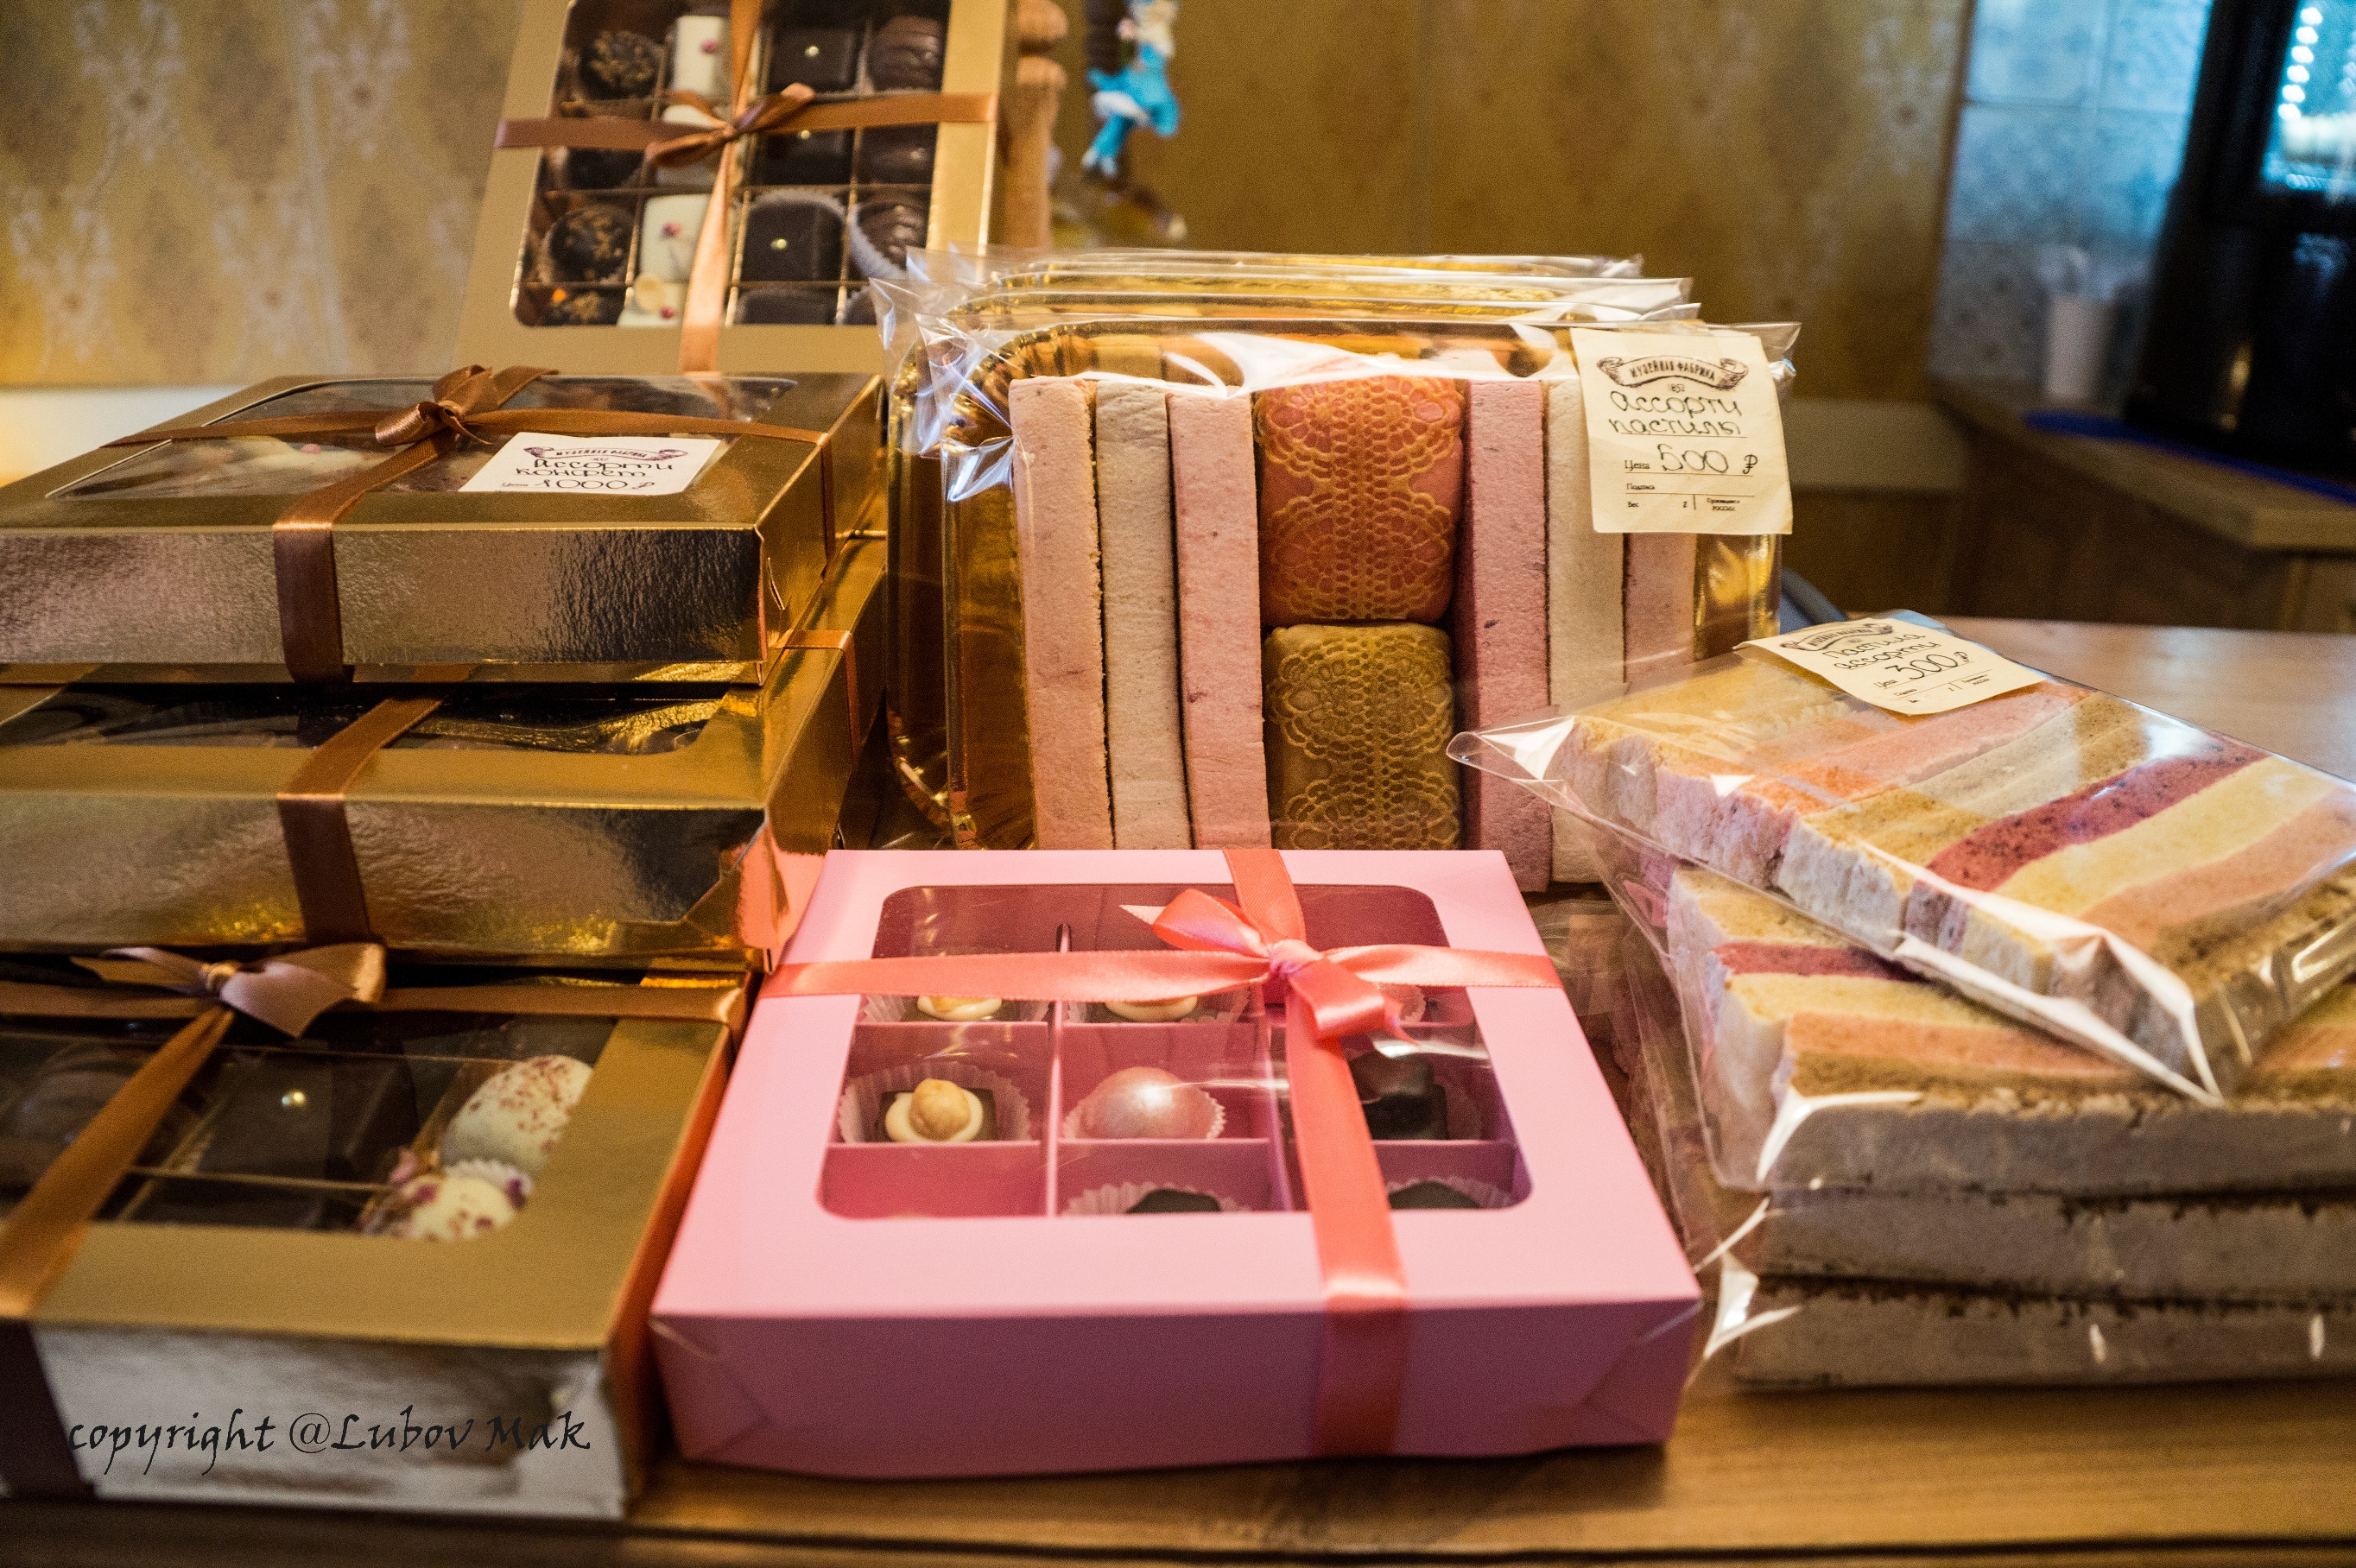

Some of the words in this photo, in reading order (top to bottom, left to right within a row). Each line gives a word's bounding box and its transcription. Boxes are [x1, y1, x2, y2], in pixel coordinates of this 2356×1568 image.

[1676, 361, 1715, 381] ФАБРИКА
[534, 458, 674, 471] Ассорти
[1624, 459, 1651, 471] Цена
[1657, 443, 1729, 473] 500
[534, 479, 629, 490] 1000
[1884, 654, 1959, 680] 300
